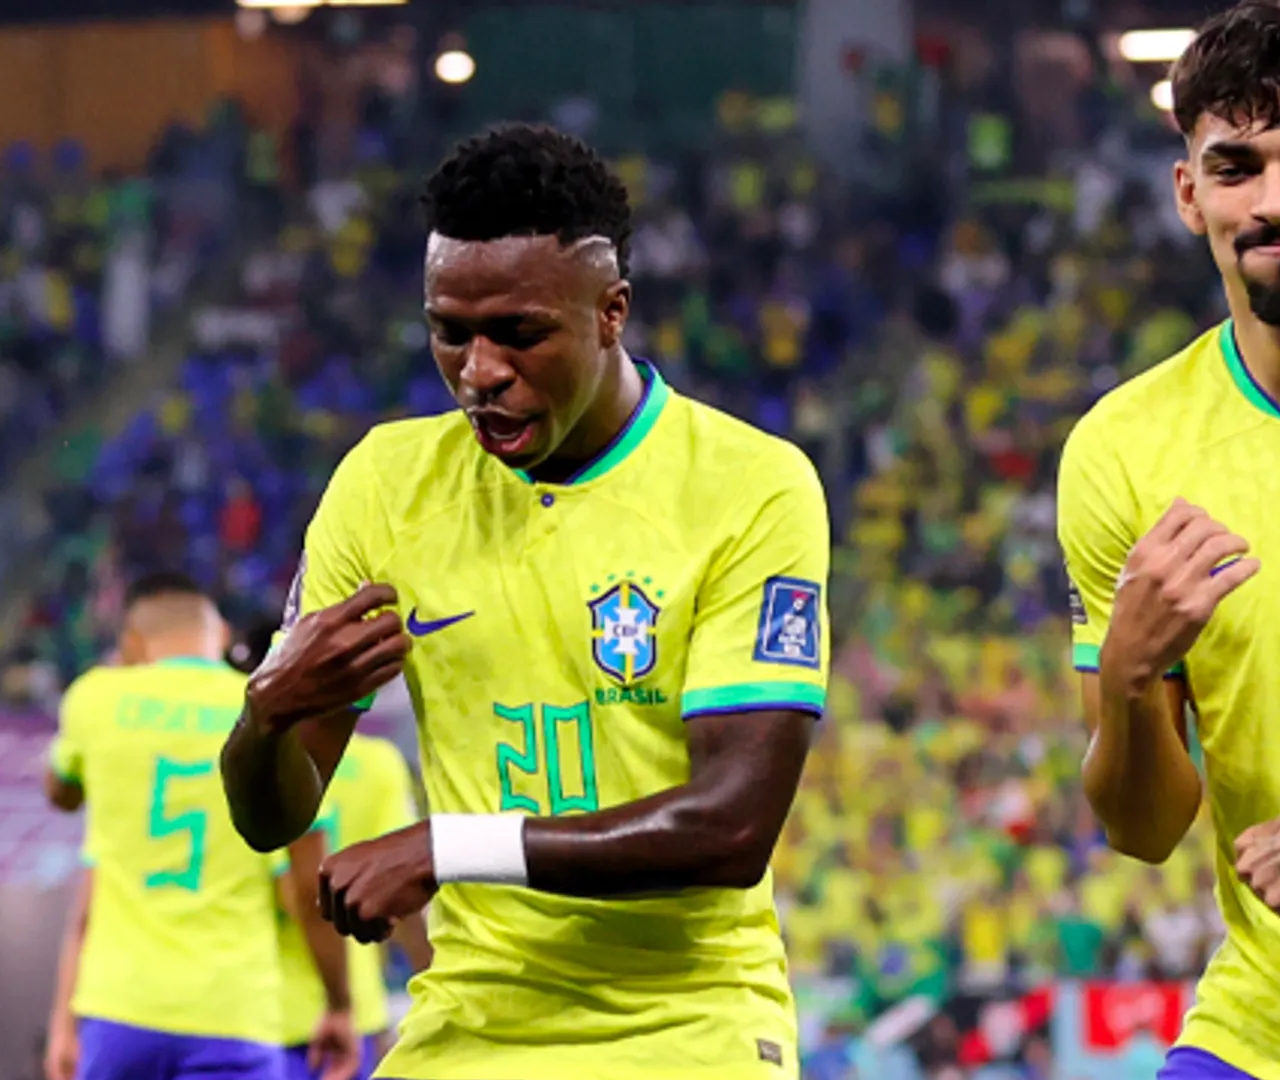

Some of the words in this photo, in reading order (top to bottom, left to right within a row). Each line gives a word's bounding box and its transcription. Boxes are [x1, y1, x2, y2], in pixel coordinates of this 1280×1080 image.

[594, 686, 668, 706] BRASIL
[493, 700, 600, 816] 20
[144, 756, 215, 892] 5
